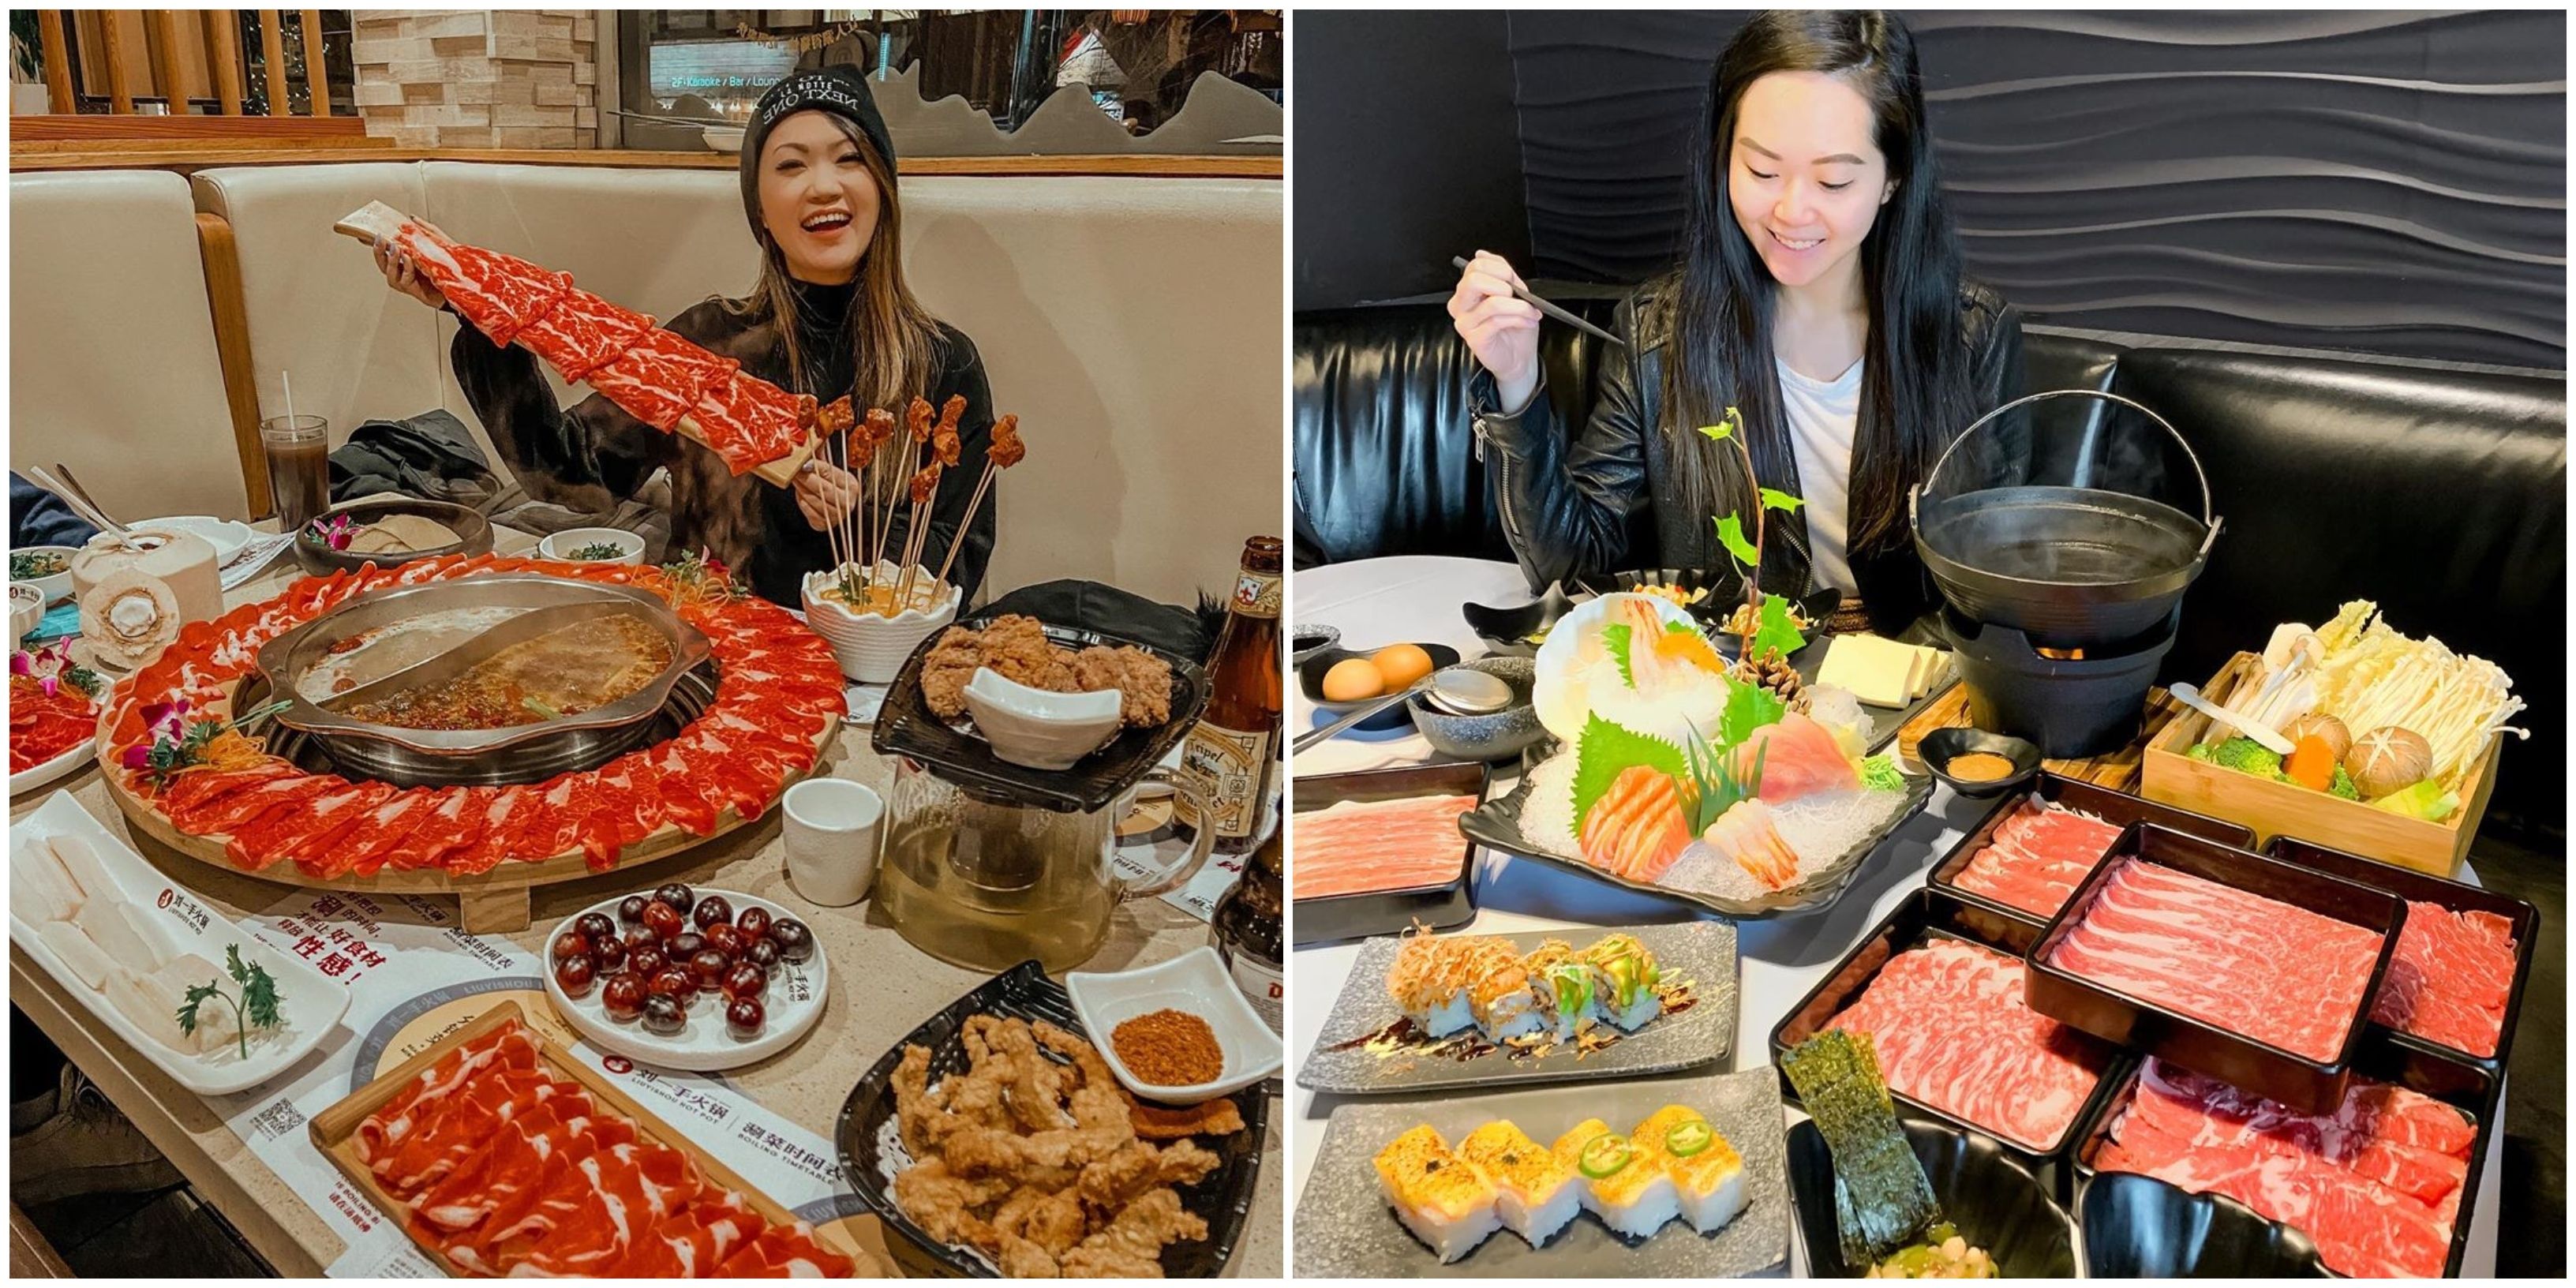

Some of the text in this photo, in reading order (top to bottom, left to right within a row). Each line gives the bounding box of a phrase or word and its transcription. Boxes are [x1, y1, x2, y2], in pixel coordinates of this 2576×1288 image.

[729, 76, 744, 87] Bar
[631, 1077, 718, 1124] LIUYISHOU HOT POT
[635, 1068, 729, 1120] 刘一手火锅
[738, 1133, 836, 1185] BOILING TIMETABLE
[742, 1121, 844, 1181] 涮菜时间表
